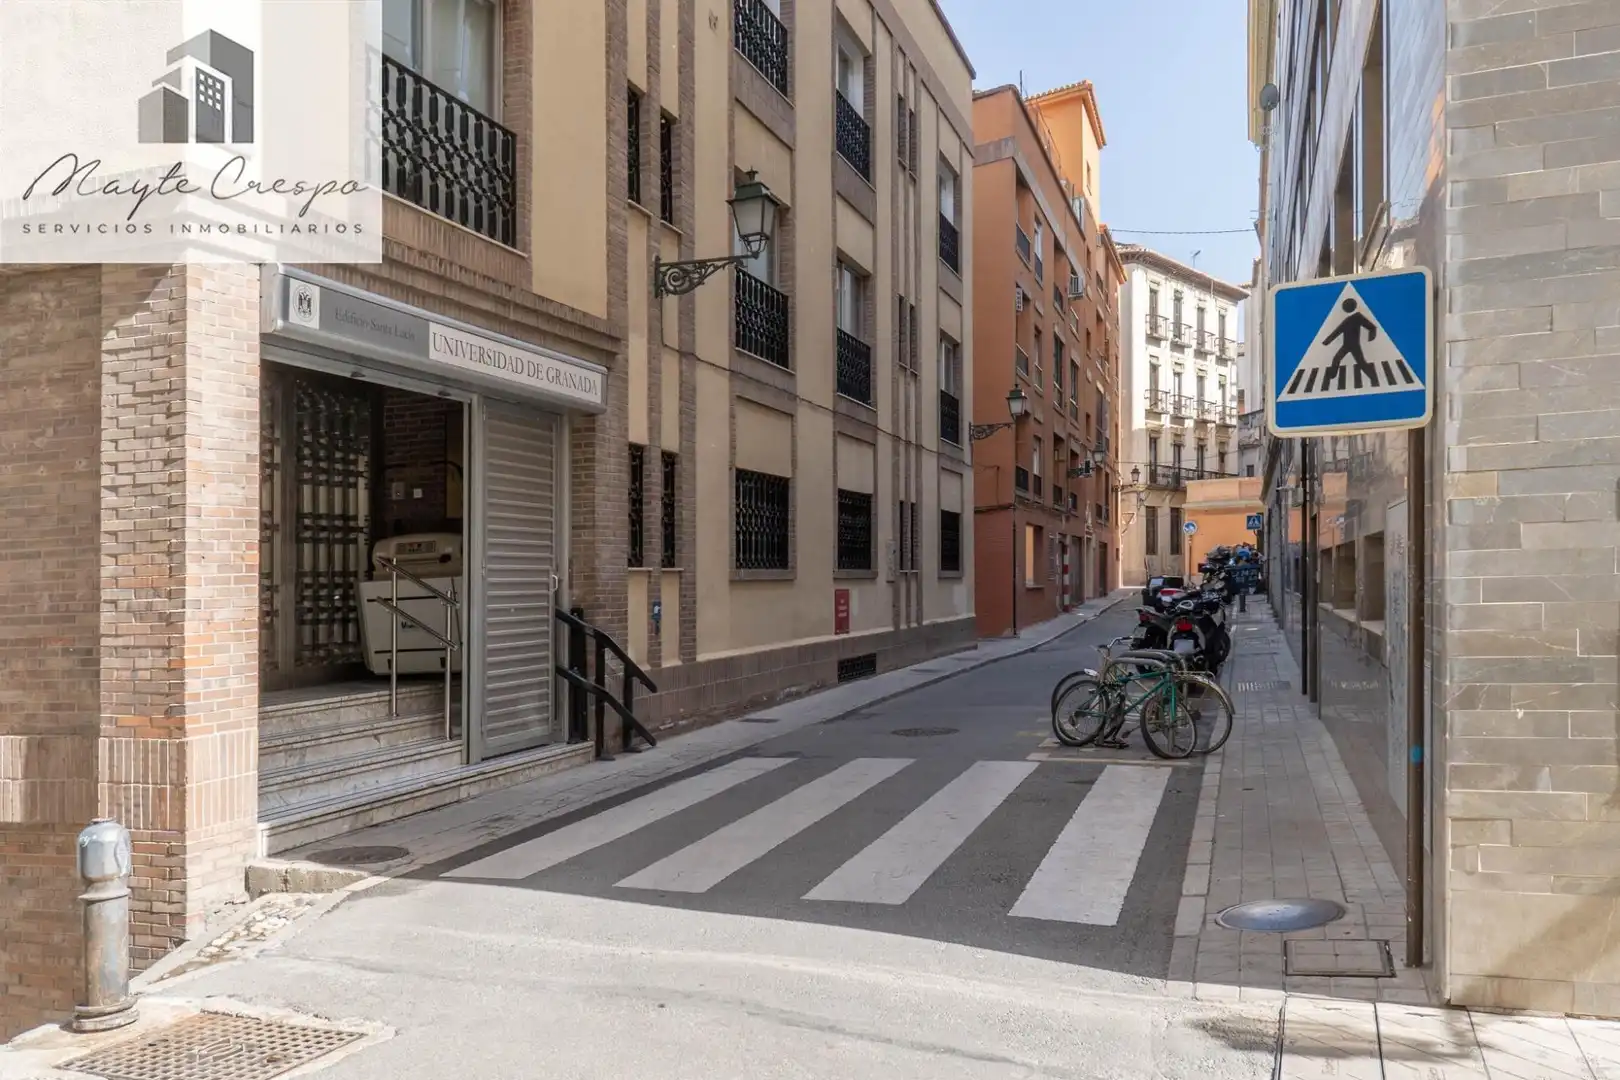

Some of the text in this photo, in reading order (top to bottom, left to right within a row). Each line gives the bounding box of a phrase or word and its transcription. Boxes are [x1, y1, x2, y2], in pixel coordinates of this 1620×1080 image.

[369, 318, 392, 336] Santa
[432, 331, 598, 396] UNIVERSIDAD DE GRANADA
